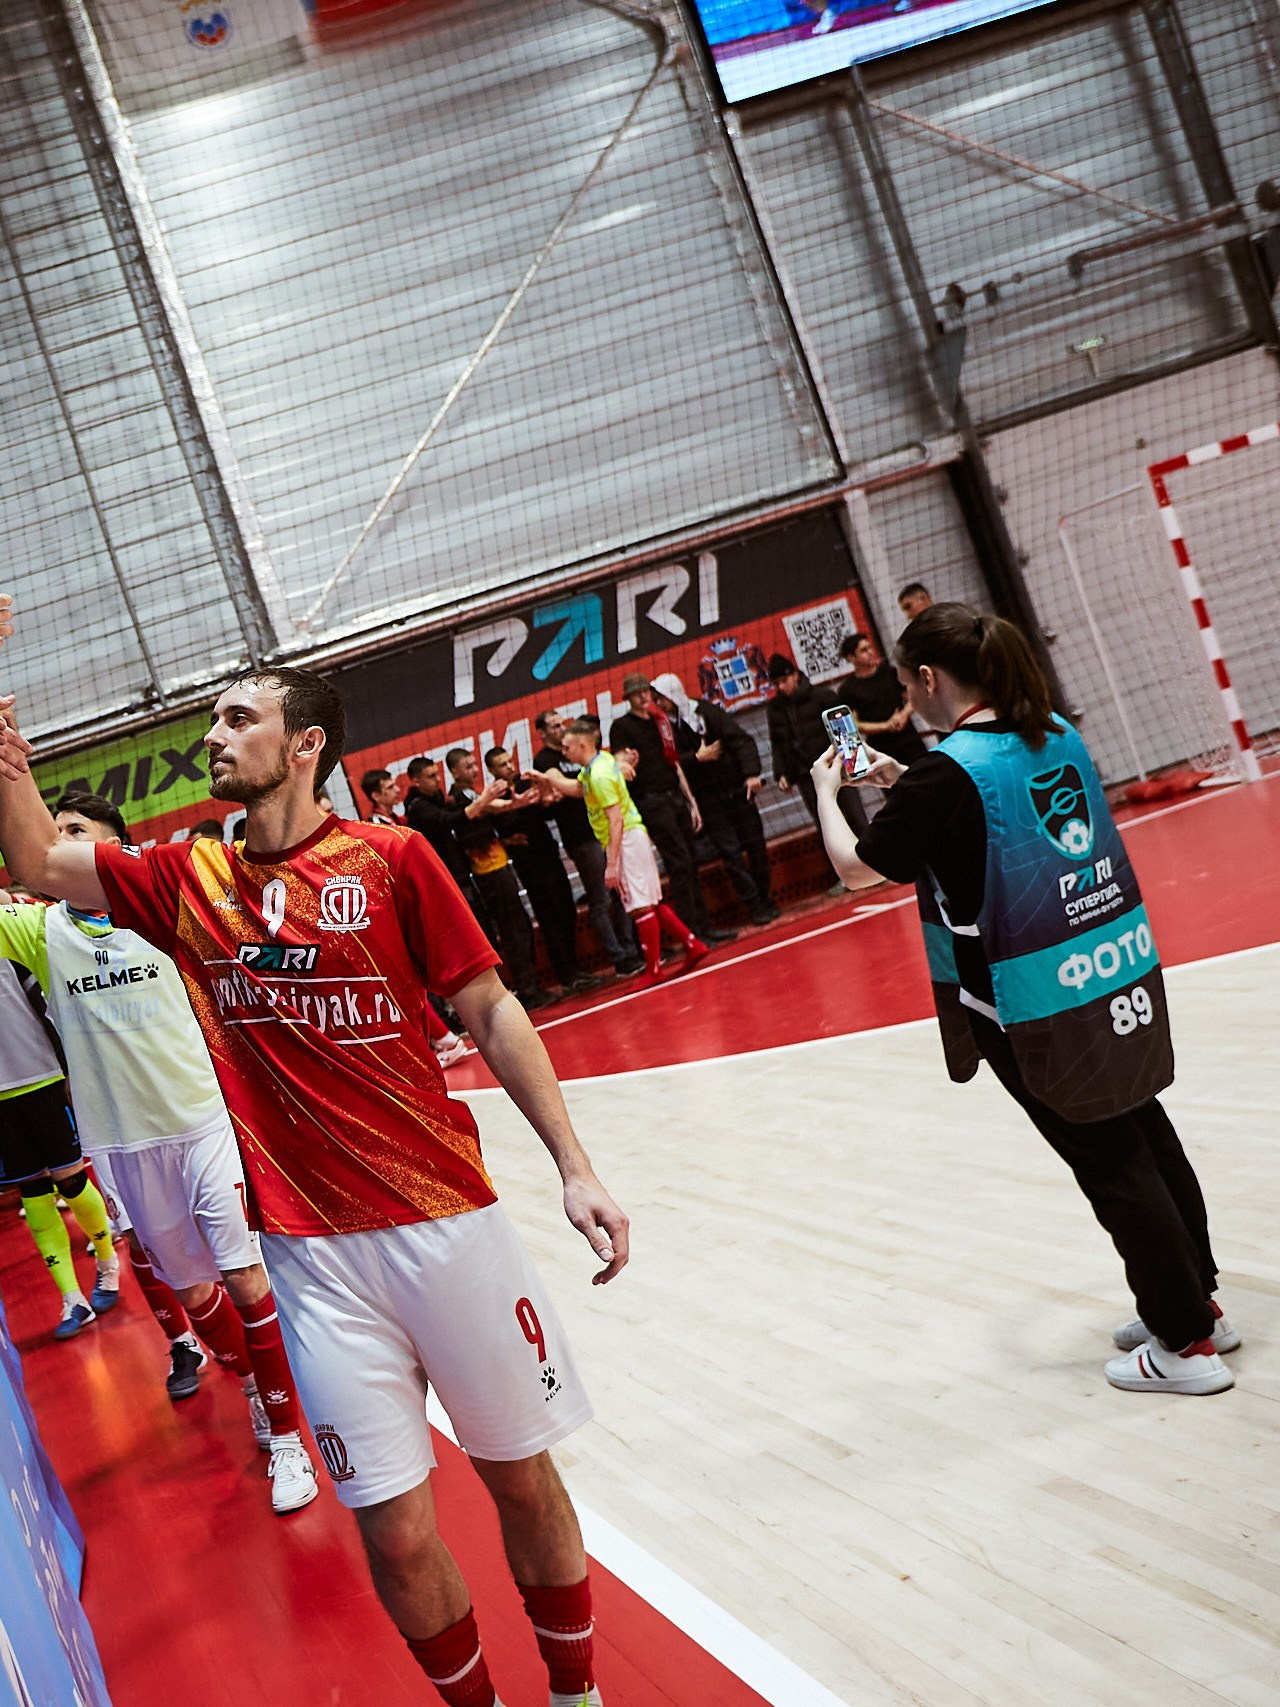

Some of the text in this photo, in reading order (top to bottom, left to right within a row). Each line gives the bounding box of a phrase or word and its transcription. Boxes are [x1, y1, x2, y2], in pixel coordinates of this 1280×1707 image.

[453, 552, 719, 708] PARI
[1058, 856, 1113, 899] PARI
[261, 878, 287, 938] 9
[66, 966, 144, 996] KELME
[94, 950, 110, 966] 90
[238, 945, 317, 969] PARI
[1057, 922, 1152, 990] ФОТО
[1109, 986, 1153, 1036] 89
[515, 1296, 547, 1364] 9
